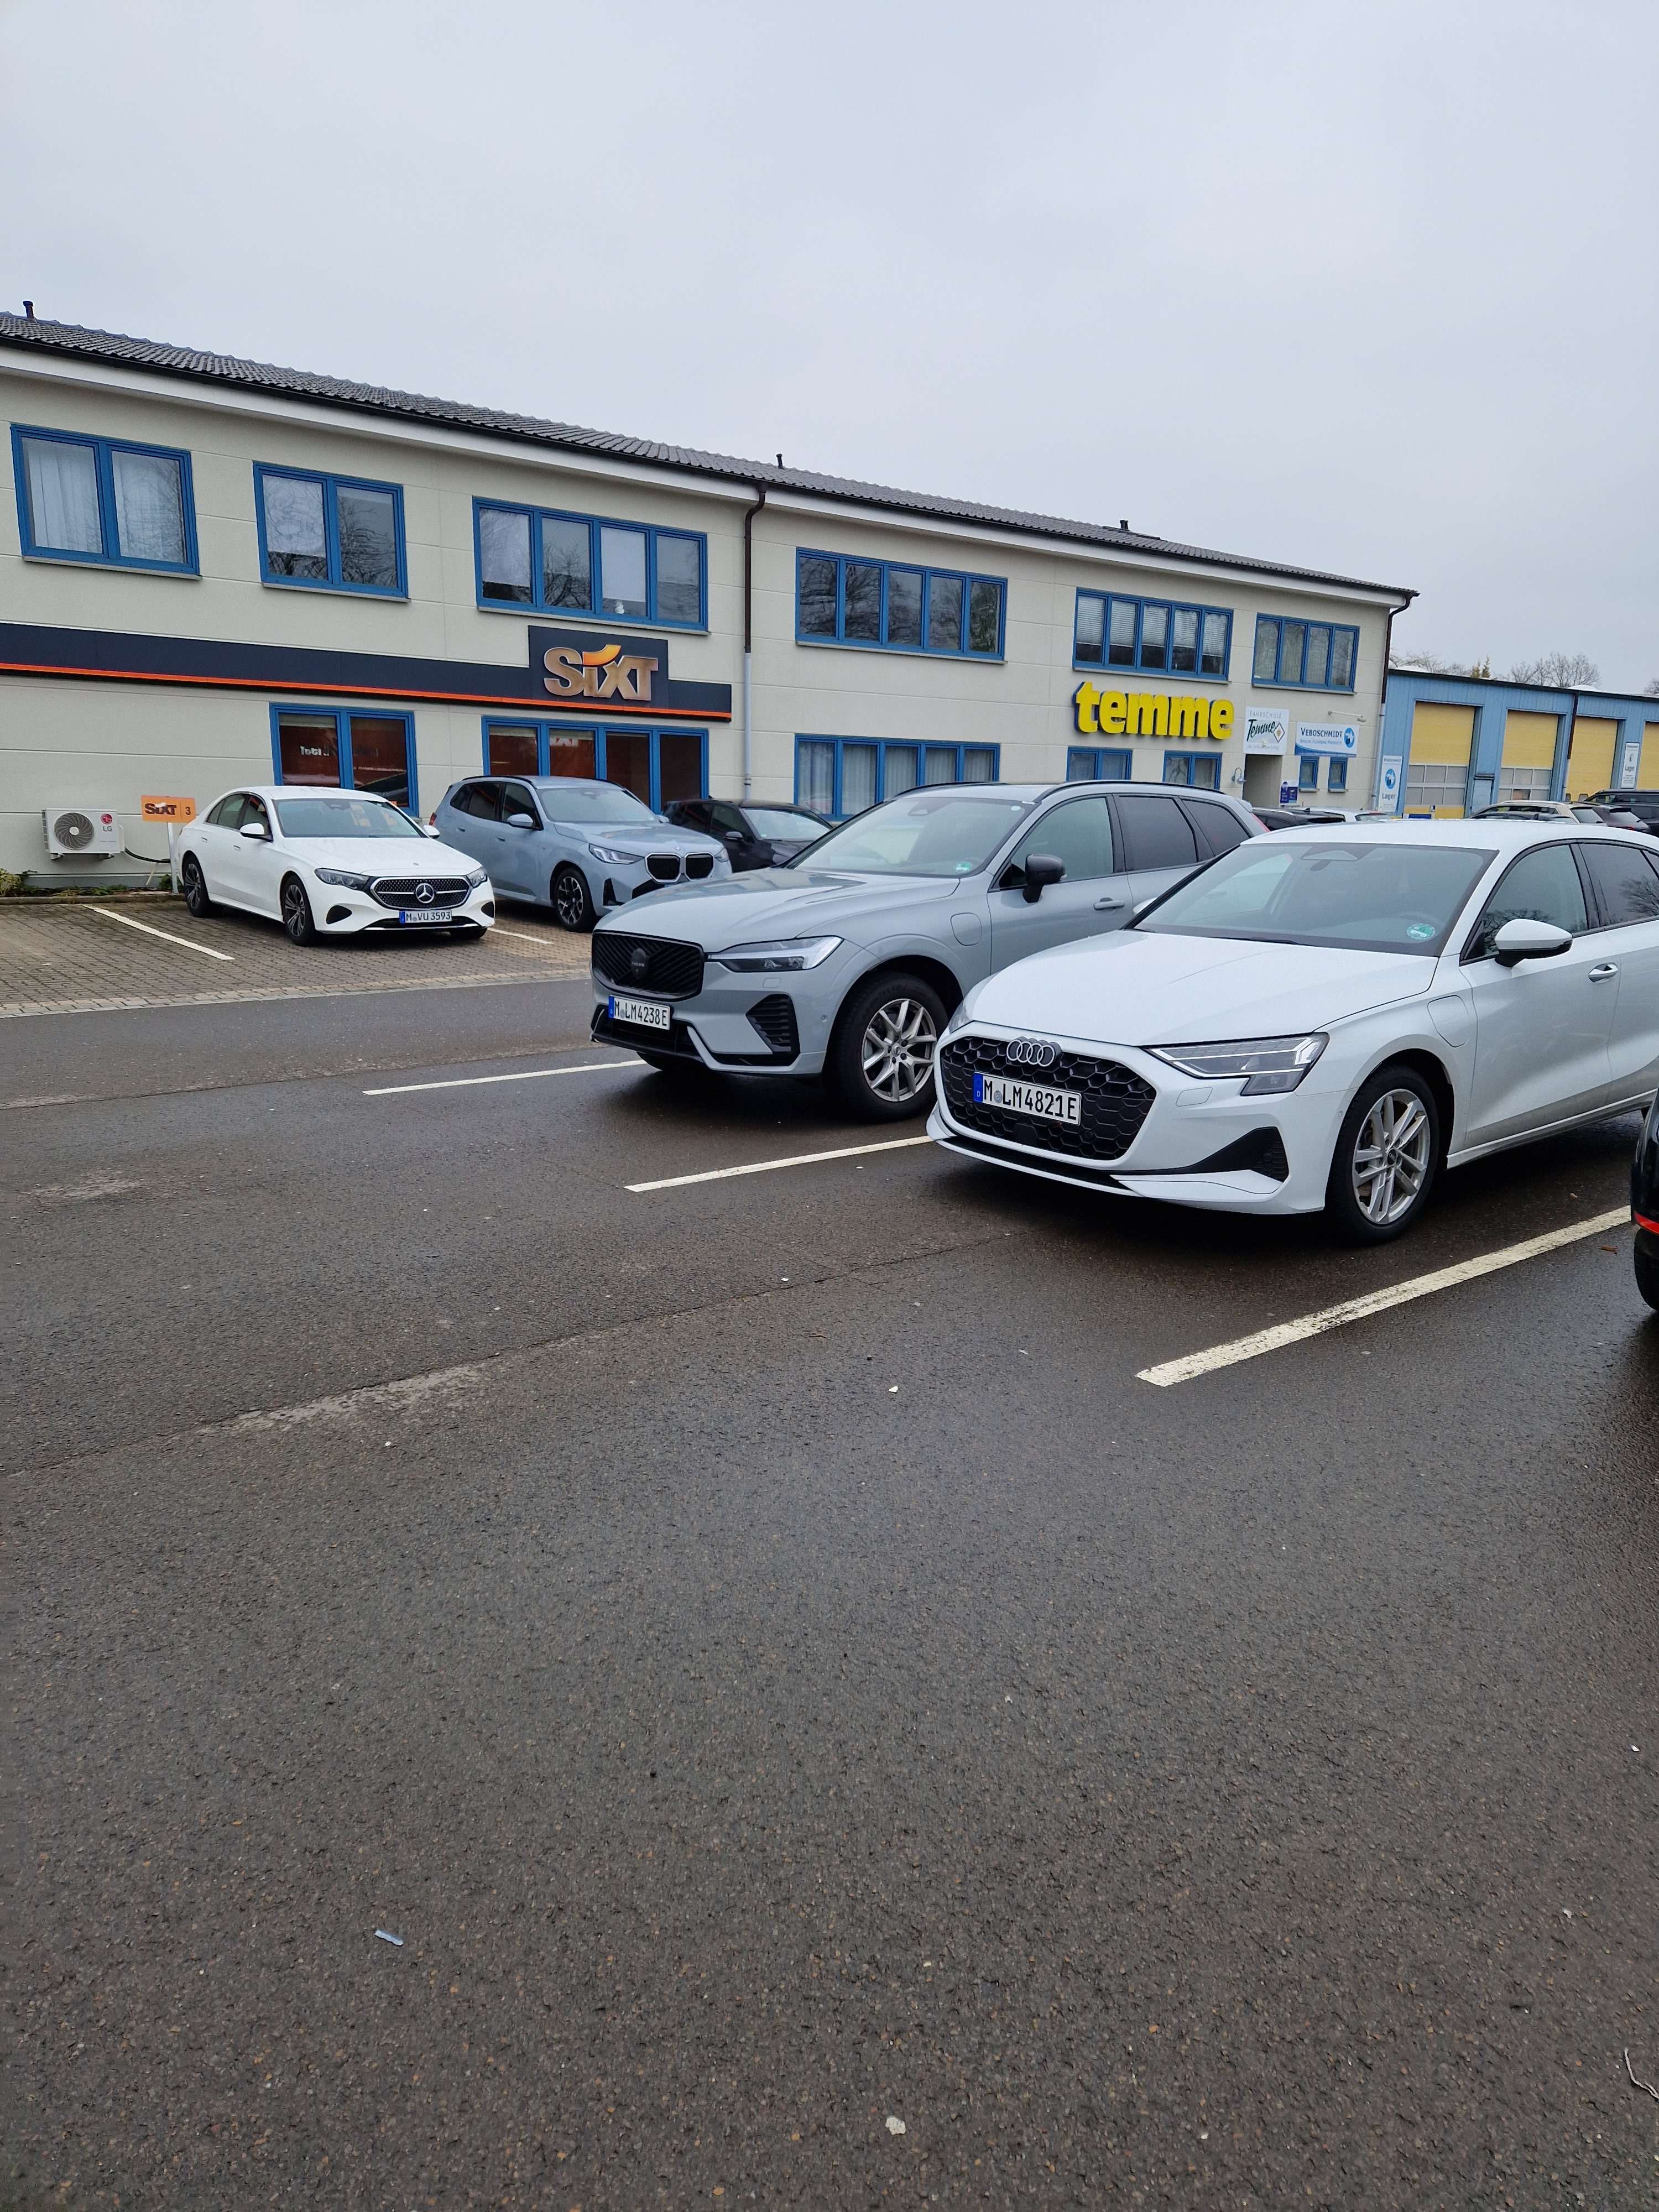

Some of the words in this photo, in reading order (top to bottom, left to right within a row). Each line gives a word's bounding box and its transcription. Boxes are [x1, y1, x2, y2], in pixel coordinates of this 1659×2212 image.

[1073, 681, 1234, 739] temme
[1250, 711, 1282, 719] FAHRSCHULE
[1246, 719, 1276, 742] Temme
[185, 806, 191, 816] 3
